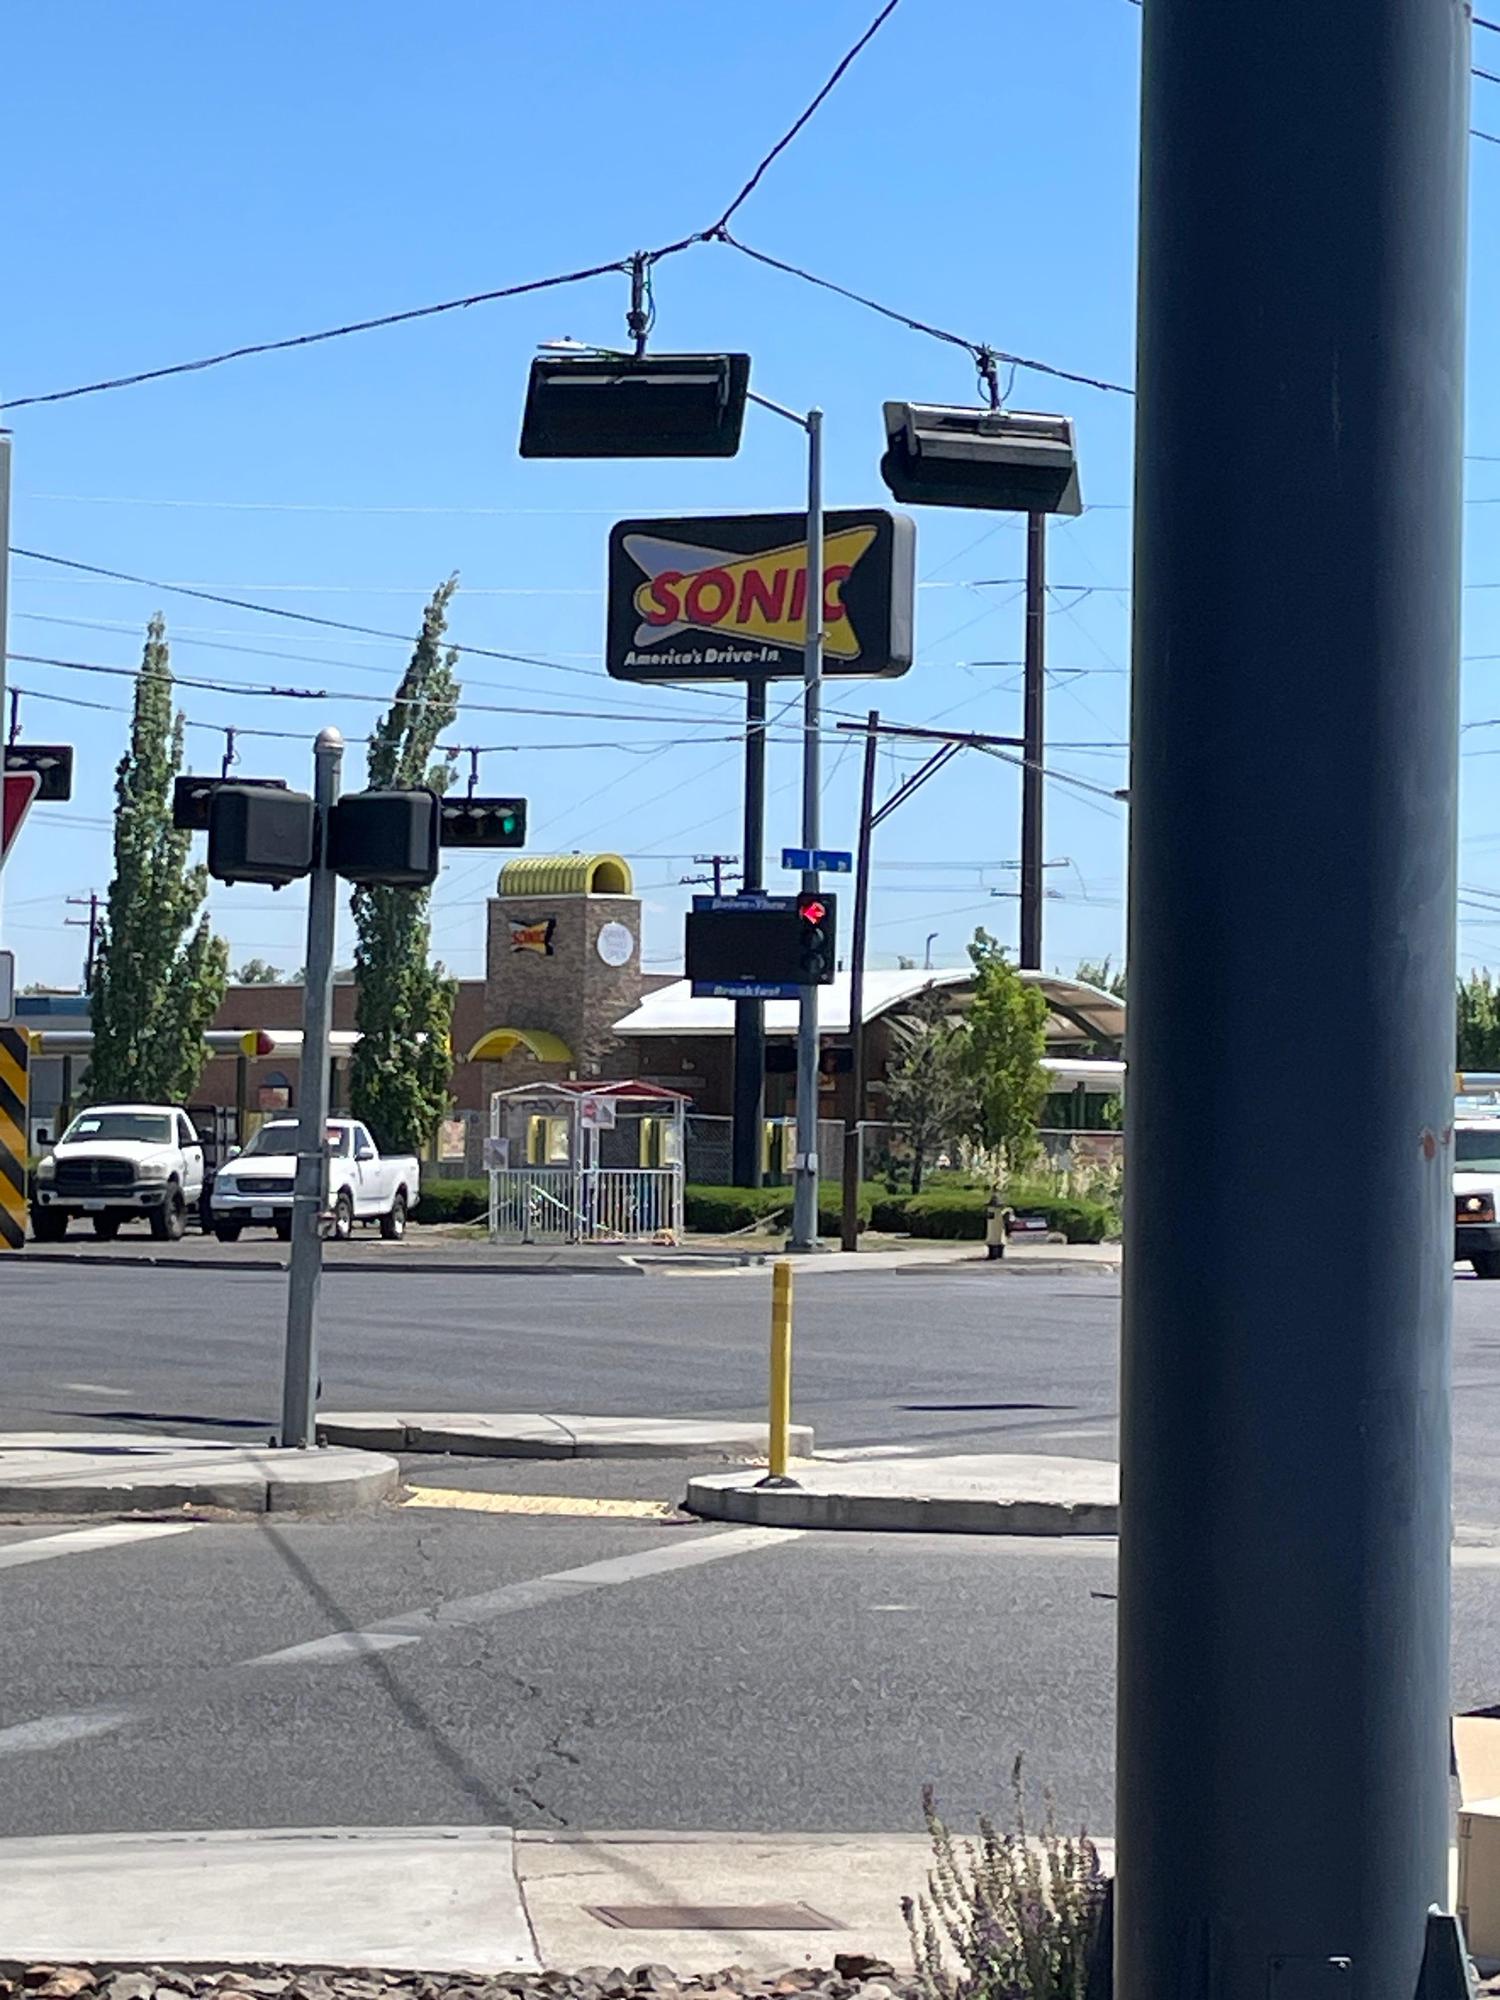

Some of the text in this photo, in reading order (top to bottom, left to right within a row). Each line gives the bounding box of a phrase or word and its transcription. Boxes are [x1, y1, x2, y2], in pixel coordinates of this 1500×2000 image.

[646, 566, 853, 626] SONIC
[624, 646, 779, 667] America's Drive-In
[713, 984, 781, 996] Breakfast
